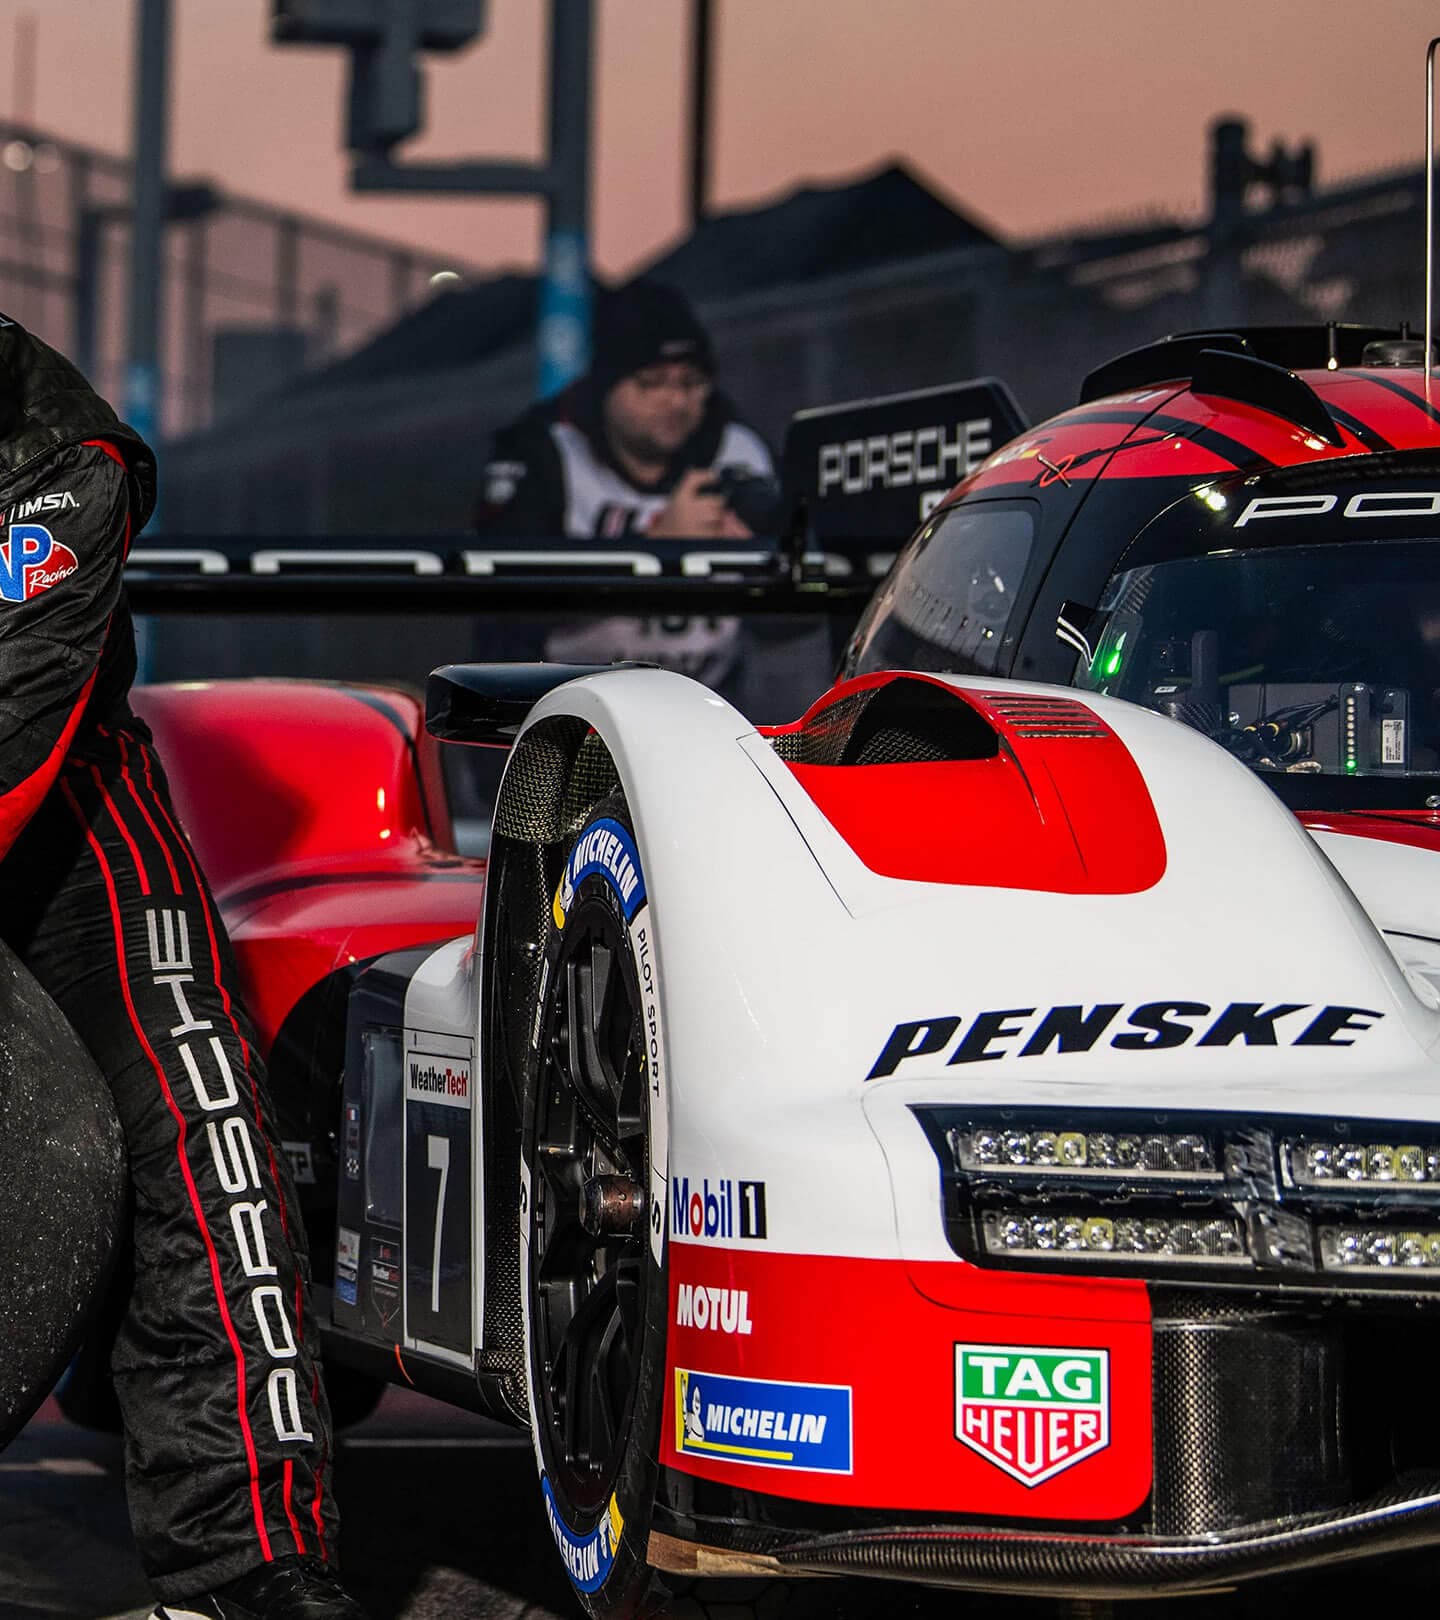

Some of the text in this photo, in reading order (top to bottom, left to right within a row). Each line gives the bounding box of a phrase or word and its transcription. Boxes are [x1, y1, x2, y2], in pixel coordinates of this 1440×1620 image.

[818, 418, 991, 497] PORSCHE
[573, 828, 638, 904] MICHELIN
[637, 927, 660, 1098] PILOT SPORT
[864, 1001, 1386, 1081] PENSKE
[411, 1063, 468, 1097] WeatherTech
[145, 908, 314, 1443] PORSCHE
[672, 1176, 733, 1239] Mobil
[428, 1134, 450, 1312] 7
[677, 1284, 753, 1335] MOTUL
[968, 1355, 1094, 1400] TAG
[705, 1402, 827, 1445] MICHELIN
[964, 1409, 1099, 1475] HEUER
